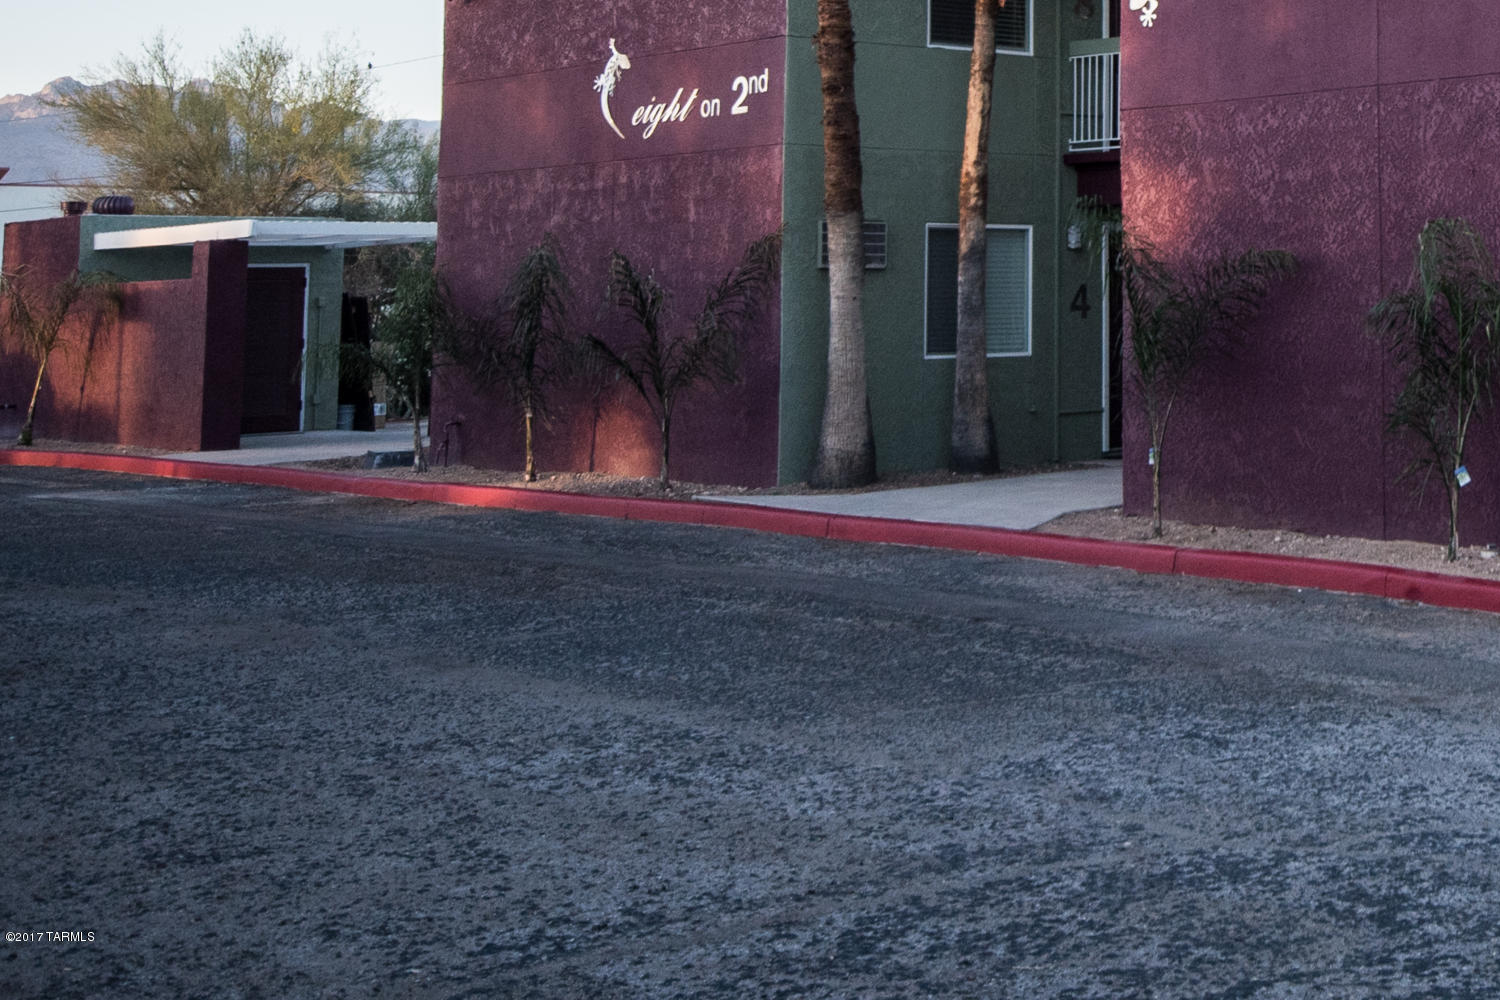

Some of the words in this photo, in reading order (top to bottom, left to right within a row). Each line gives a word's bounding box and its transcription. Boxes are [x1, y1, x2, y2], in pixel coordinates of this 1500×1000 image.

[632, 87, 698, 139] eight
[700, 98, 720, 118] on
[731, 68, 768, 115] 2nd
[1070, 283, 1091, 319] 4
